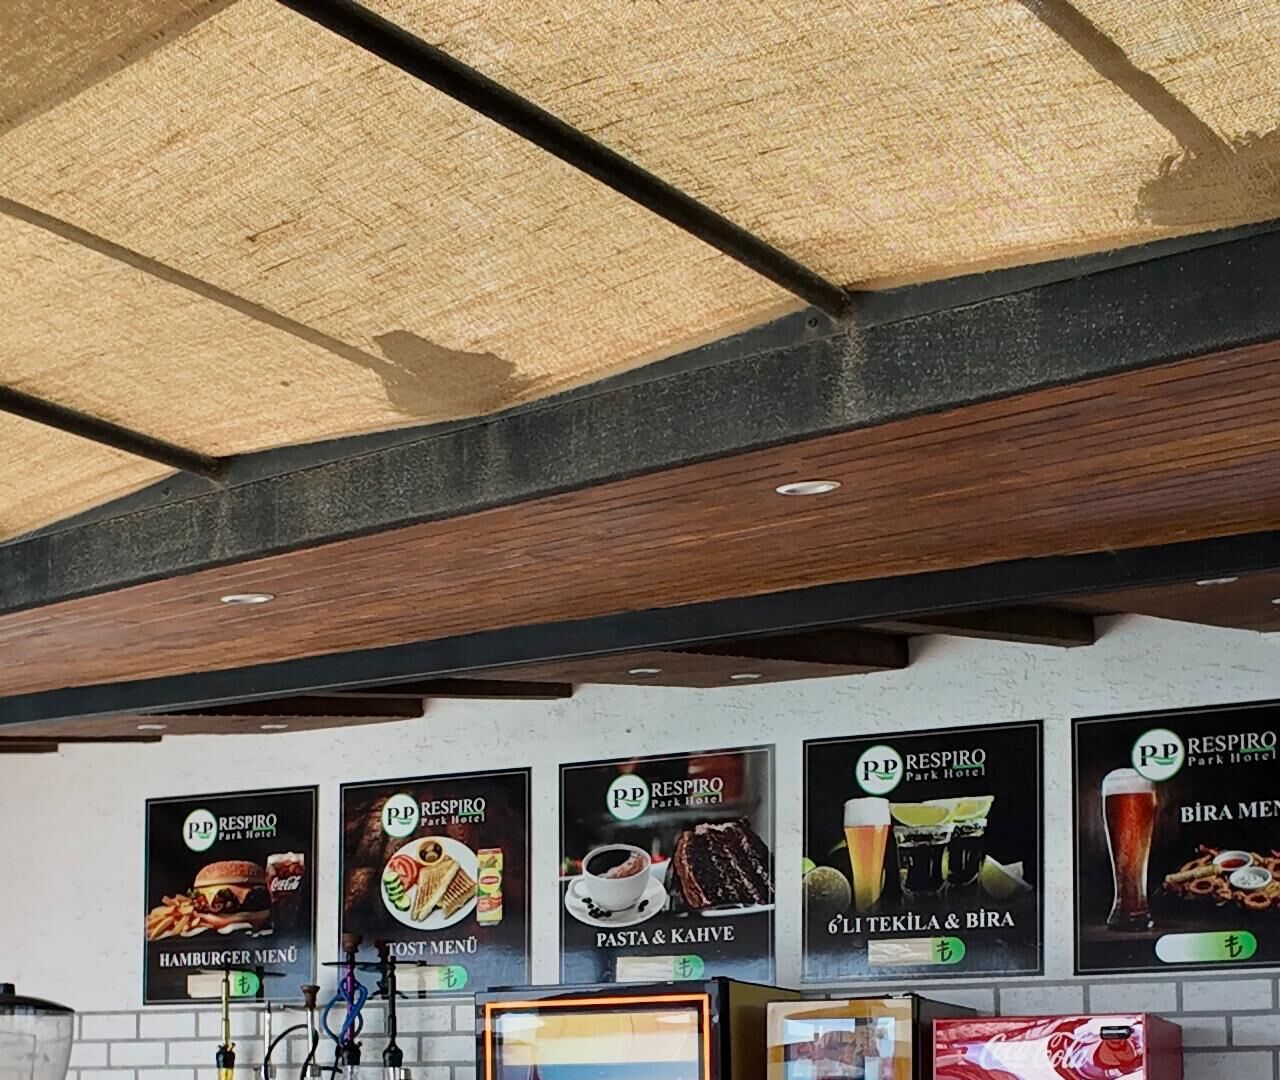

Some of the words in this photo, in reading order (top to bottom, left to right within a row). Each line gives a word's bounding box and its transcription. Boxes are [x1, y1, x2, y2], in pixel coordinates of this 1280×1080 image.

[1188, 731, 1277, 754] RESPIRO
[906, 748, 986, 771] RESPIRO
[1188, 754, 1224, 767] Park
[1230, 749, 1277, 764] Hotel
[906, 769, 938, 782] Park
[943, 764, 985, 779] Hotel
[651, 776, 723, 798] RESPIRO
[421, 798, 486, 816] RESPIRO
[651, 797, 681, 809] Park
[686, 793, 723, 806] Hotel
[219, 813, 277, 831] RESPIRO
[421, 816, 447, 827] Park
[451, 812, 485, 824] Hotel
[1180, 802, 1233, 823] BİRA
[219, 831, 242, 841] Park
[246, 828, 277, 839] Hotel
[865, 910, 941, 933] TEKİLA
[945, 911, 961, 930] &
[965, 907, 1016, 929] BİRA
[386, 940, 427, 956] TOST
[429, 936, 478, 955] MENÜ
[597, 930, 649, 948] PASTA
[652, 929, 666, 945] &
[671, 925, 735, 943] KAHVE
[159, 950, 250, 967] HAMBURGER
[255, 945, 298, 963] MENÜ
